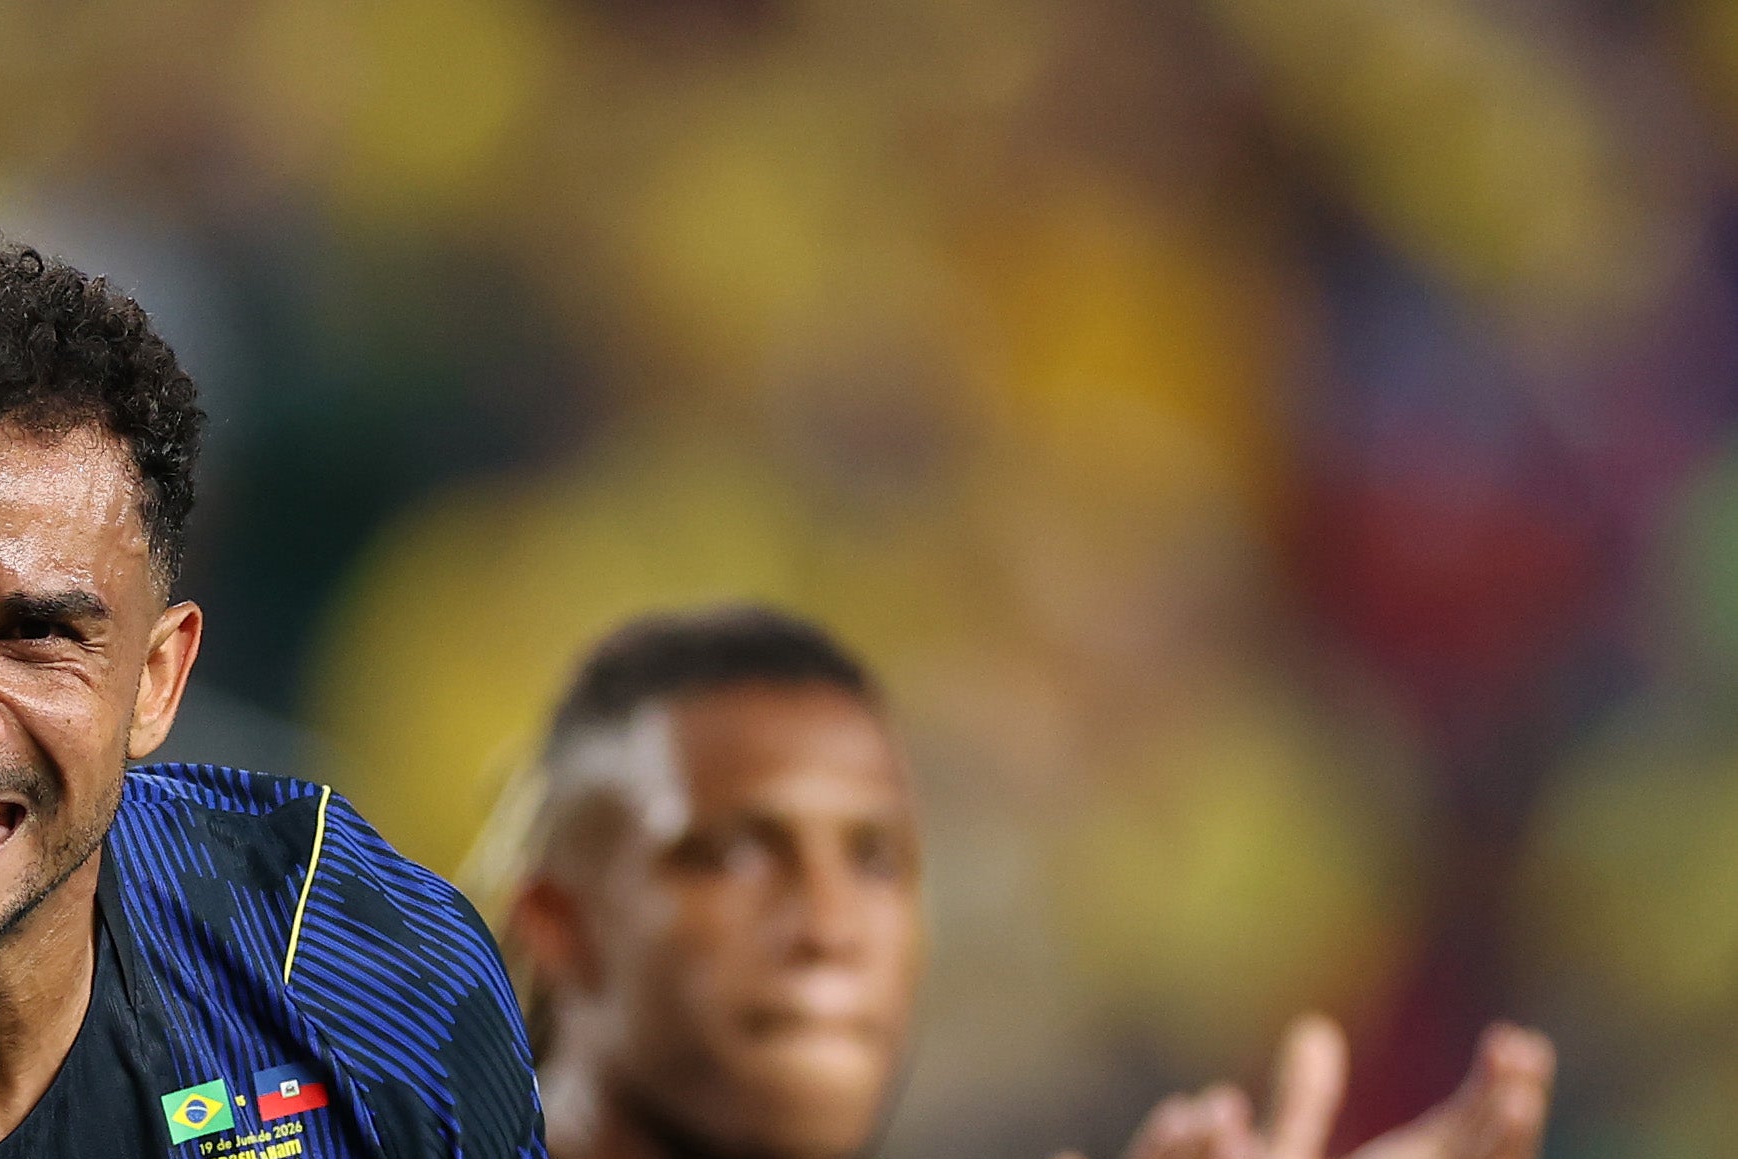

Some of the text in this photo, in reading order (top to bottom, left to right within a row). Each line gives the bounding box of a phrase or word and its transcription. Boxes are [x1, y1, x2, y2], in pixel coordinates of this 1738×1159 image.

[198, 1141, 213, 1155] 19
[216, 1137, 233, 1151] de
[258, 1129, 272, 1142] de
[272, 1120, 303, 1139] 2026
